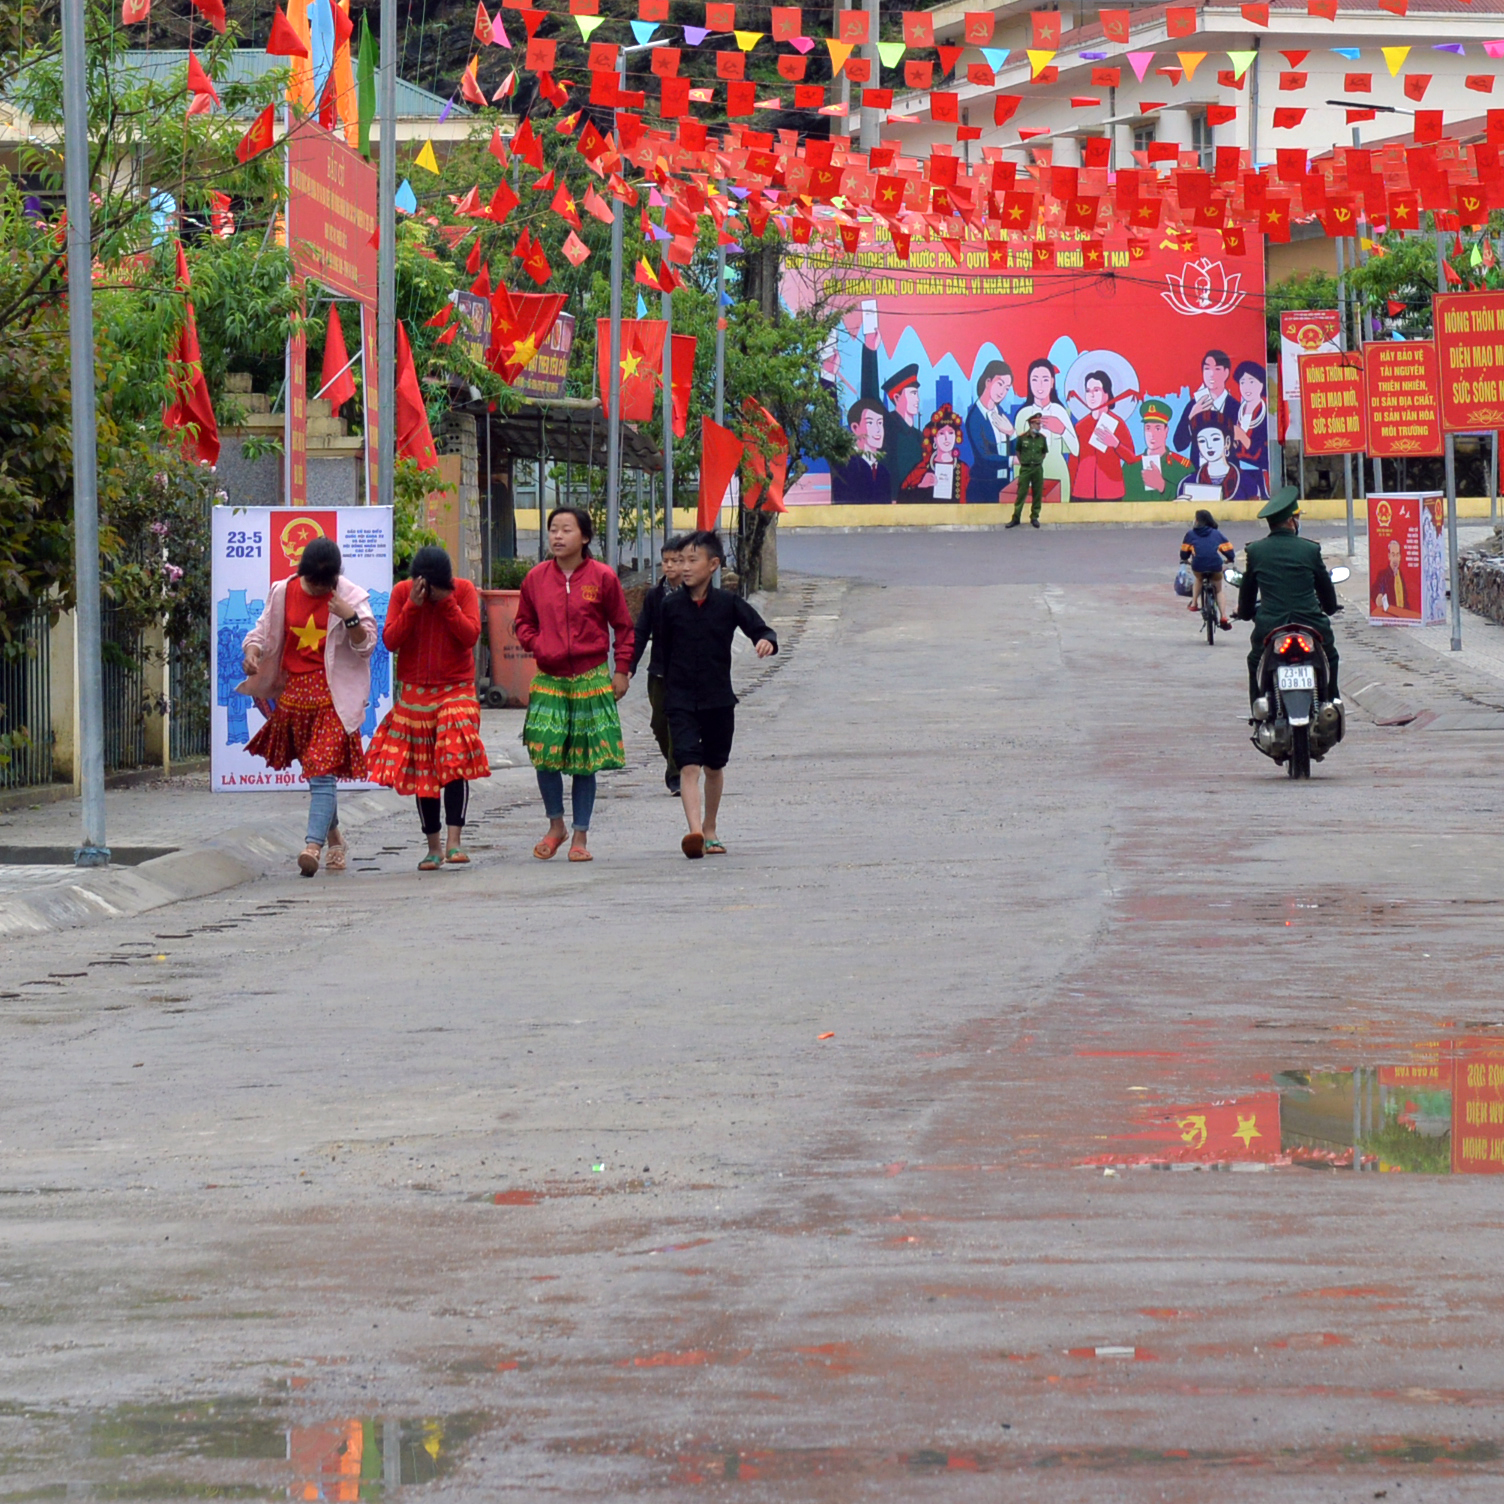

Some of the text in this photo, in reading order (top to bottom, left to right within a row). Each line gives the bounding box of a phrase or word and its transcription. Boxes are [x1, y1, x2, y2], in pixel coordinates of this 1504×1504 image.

[909, 248, 936, 268] NƯỚC
[966, 250, 989, 270] QUY
[1057, 249, 1083, 268] NGHĨ
[845, 274, 873, 295] NHÂN
[875, 274, 898, 296] DÂN,
[901, 278, 914, 295] DO
[916, 275, 944, 295] NHÂN
[946, 275, 969, 296] DÂN,
[971, 275, 981, 295] VÌ
[983, 275, 1011, 295] NHÂN
[1013, 275, 1033, 295] DÂN
[1444, 306, 1470, 333] NÔNG
[1471, 305, 1495, 332] THÔN
[1397, 347, 1413, 361] BẢO
[1414, 348, 1424, 363] VỆ
[1449, 342, 1471, 373] DIỆN
[1473, 345, 1493, 372] MẠO
[1306, 364, 1325, 383] NÔNG
[1380, 364, 1392, 377] TÀI
[1378, 379, 1400, 391] THIÊN
[1452, 376, 1471, 404] SỨC
[1473, 373, 1497, 403] SỐNG
[1310, 389, 1327, 412] DIỆN
[1327, 391, 1342, 411] MẠO
[1371, 397, 1380, 407] DI
[1381, 393, 1398, 406] SẢN
[1313, 411, 1360, 434] SỨC SỐNG MỚI
[1374, 408, 1435, 422] DI SẢN VĂN HÓA
[1381, 425, 1397, 437] MÔI
[227, 531, 263, 544] 23-5
[225, 545, 263, 559] 2021
[240, 771, 272, 785] NGÀY
[275, 771, 295, 786] HỘI
